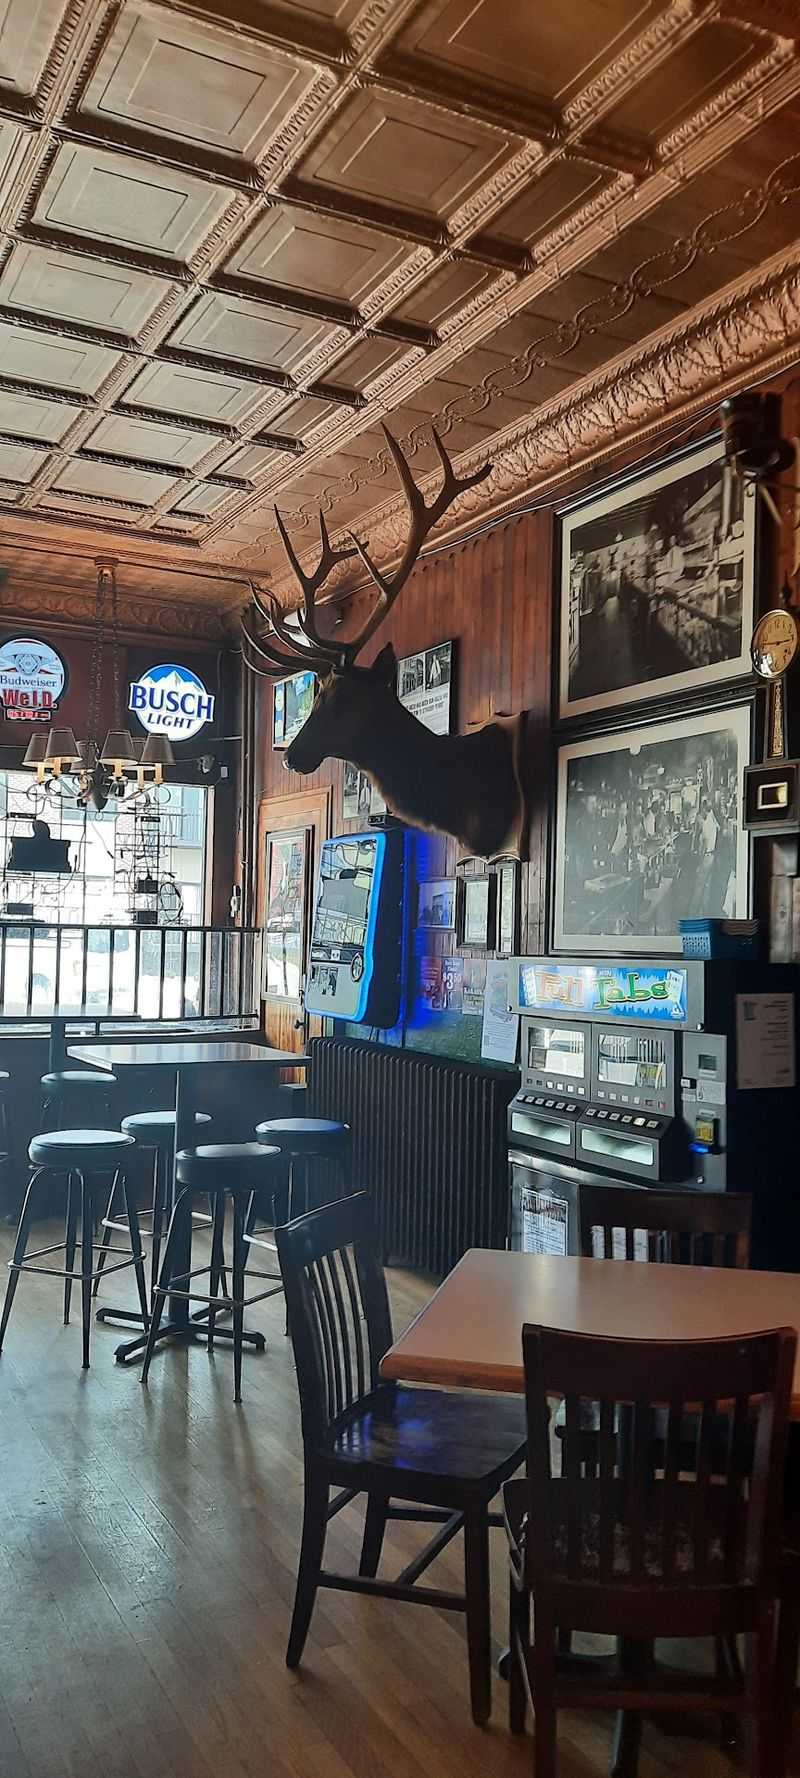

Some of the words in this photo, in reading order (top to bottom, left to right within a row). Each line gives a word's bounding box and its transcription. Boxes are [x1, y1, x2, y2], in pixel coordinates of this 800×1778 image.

[0, 675, 57, 687] Budweiser
[3, 689, 29, 706] We
[131, 684, 213, 719] BUSCH
[147, 713, 195, 729] LIGHT
[592, 972, 670, 1011] Tabs
